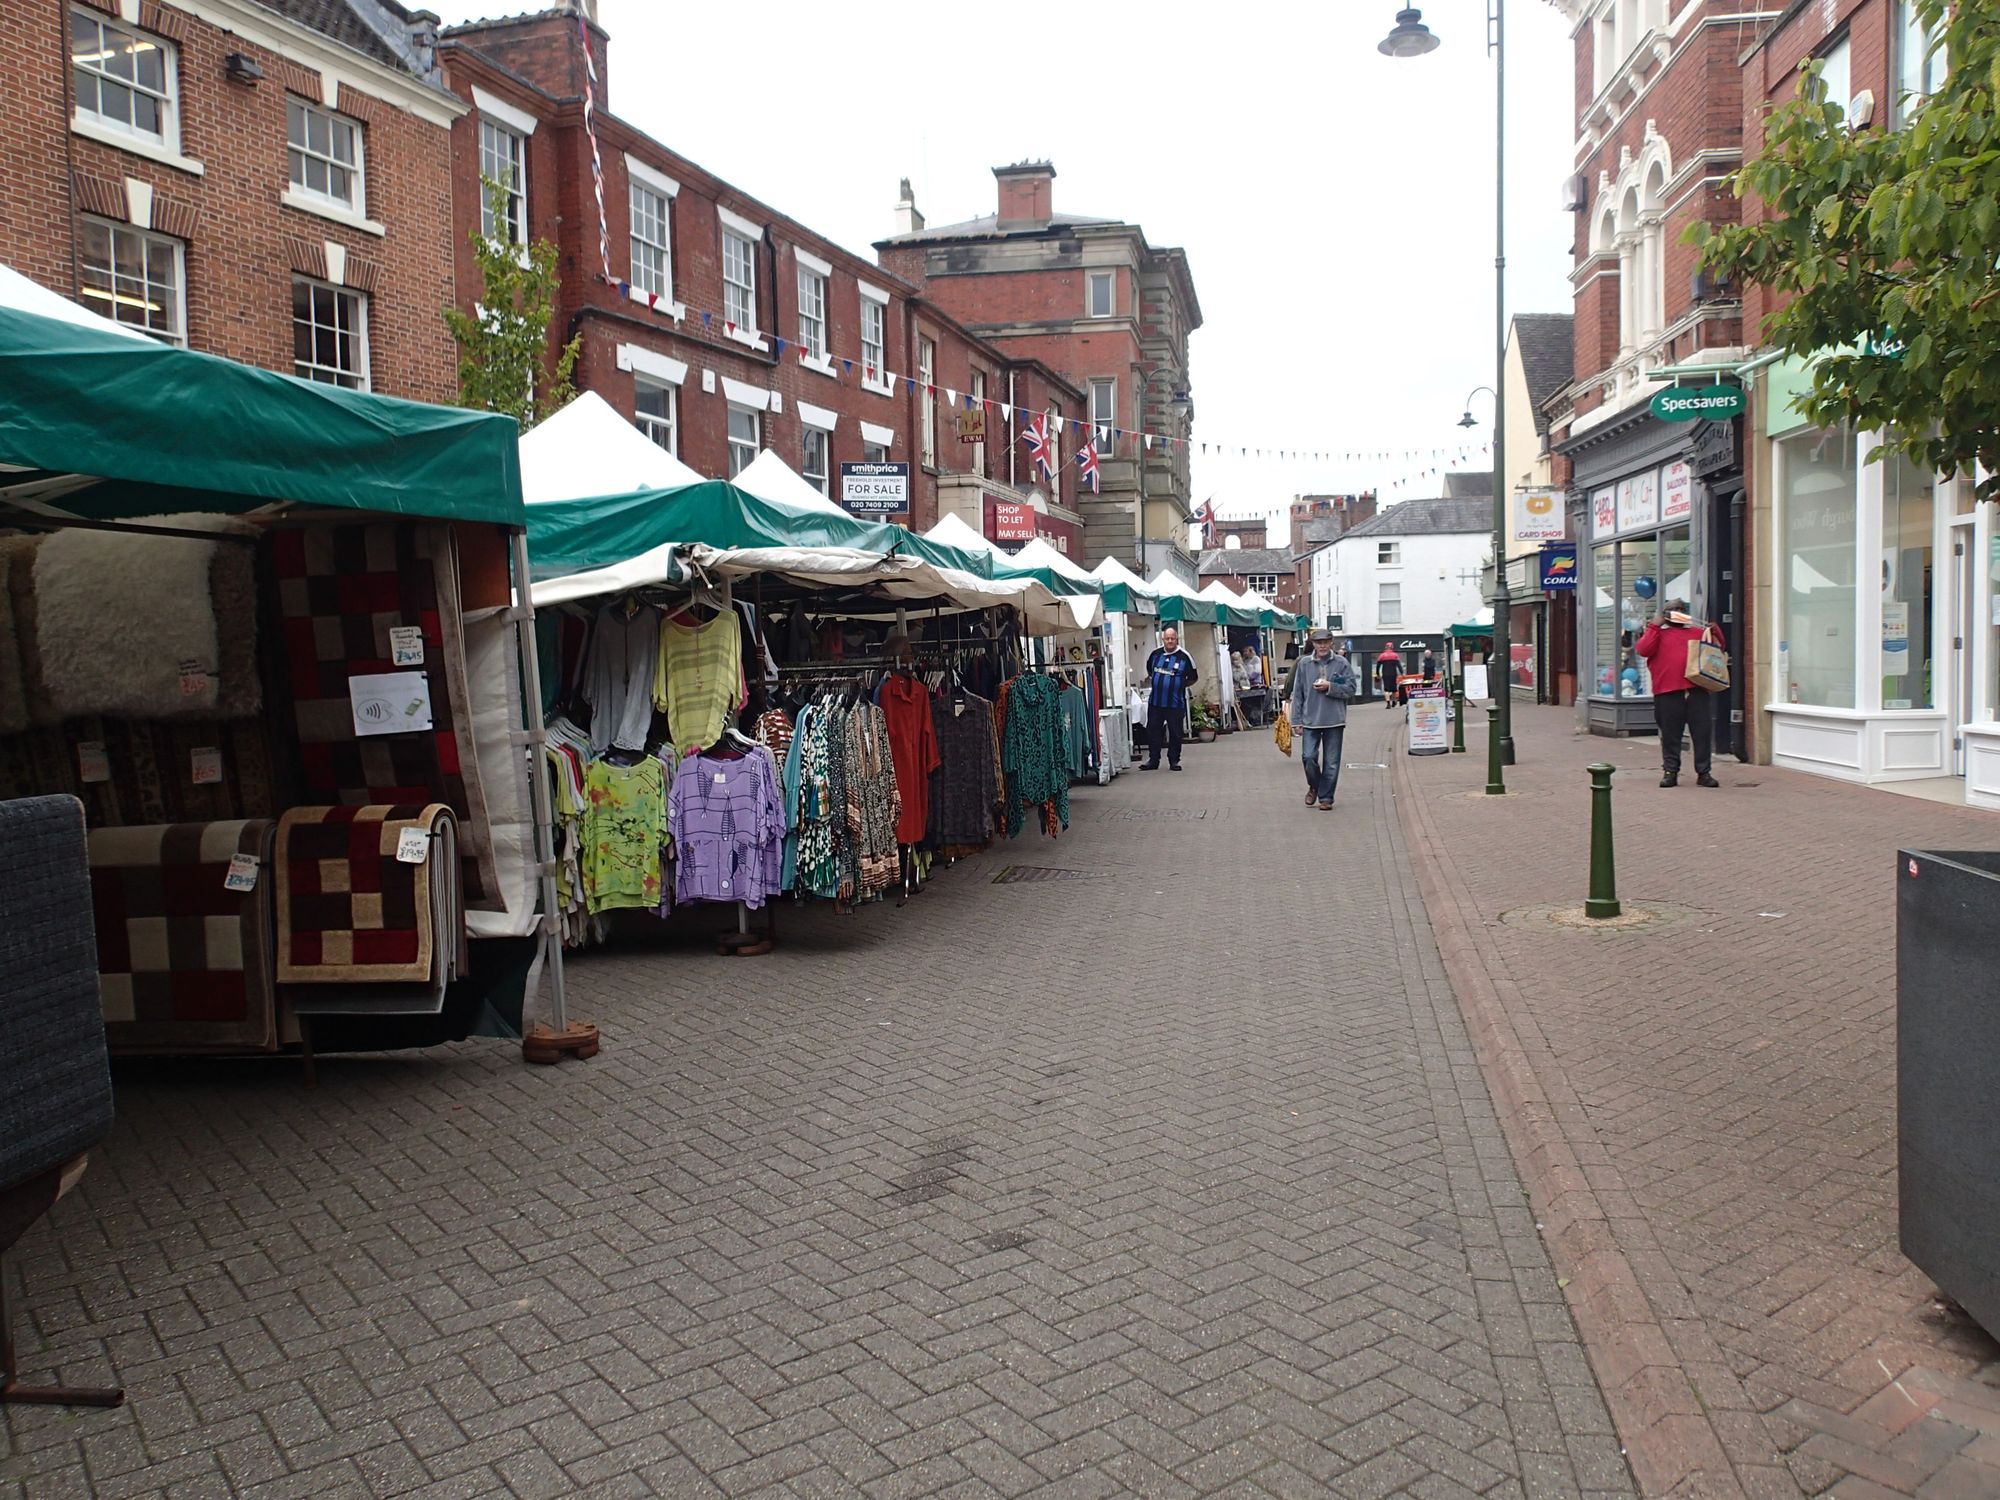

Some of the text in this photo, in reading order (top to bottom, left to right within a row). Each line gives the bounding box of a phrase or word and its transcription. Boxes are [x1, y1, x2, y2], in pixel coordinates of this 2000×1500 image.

[1661, 395, 1738, 413] Specsavers
[851, 464, 898, 475] smithprice
[848, 484, 902, 494] FOR SALE
[998, 506, 1020, 514] SHOP
[998, 516, 1024, 524] TO LET
[998, 530, 1033, 538] MAY SELL
[1399, 640, 1427, 649] Clarks
